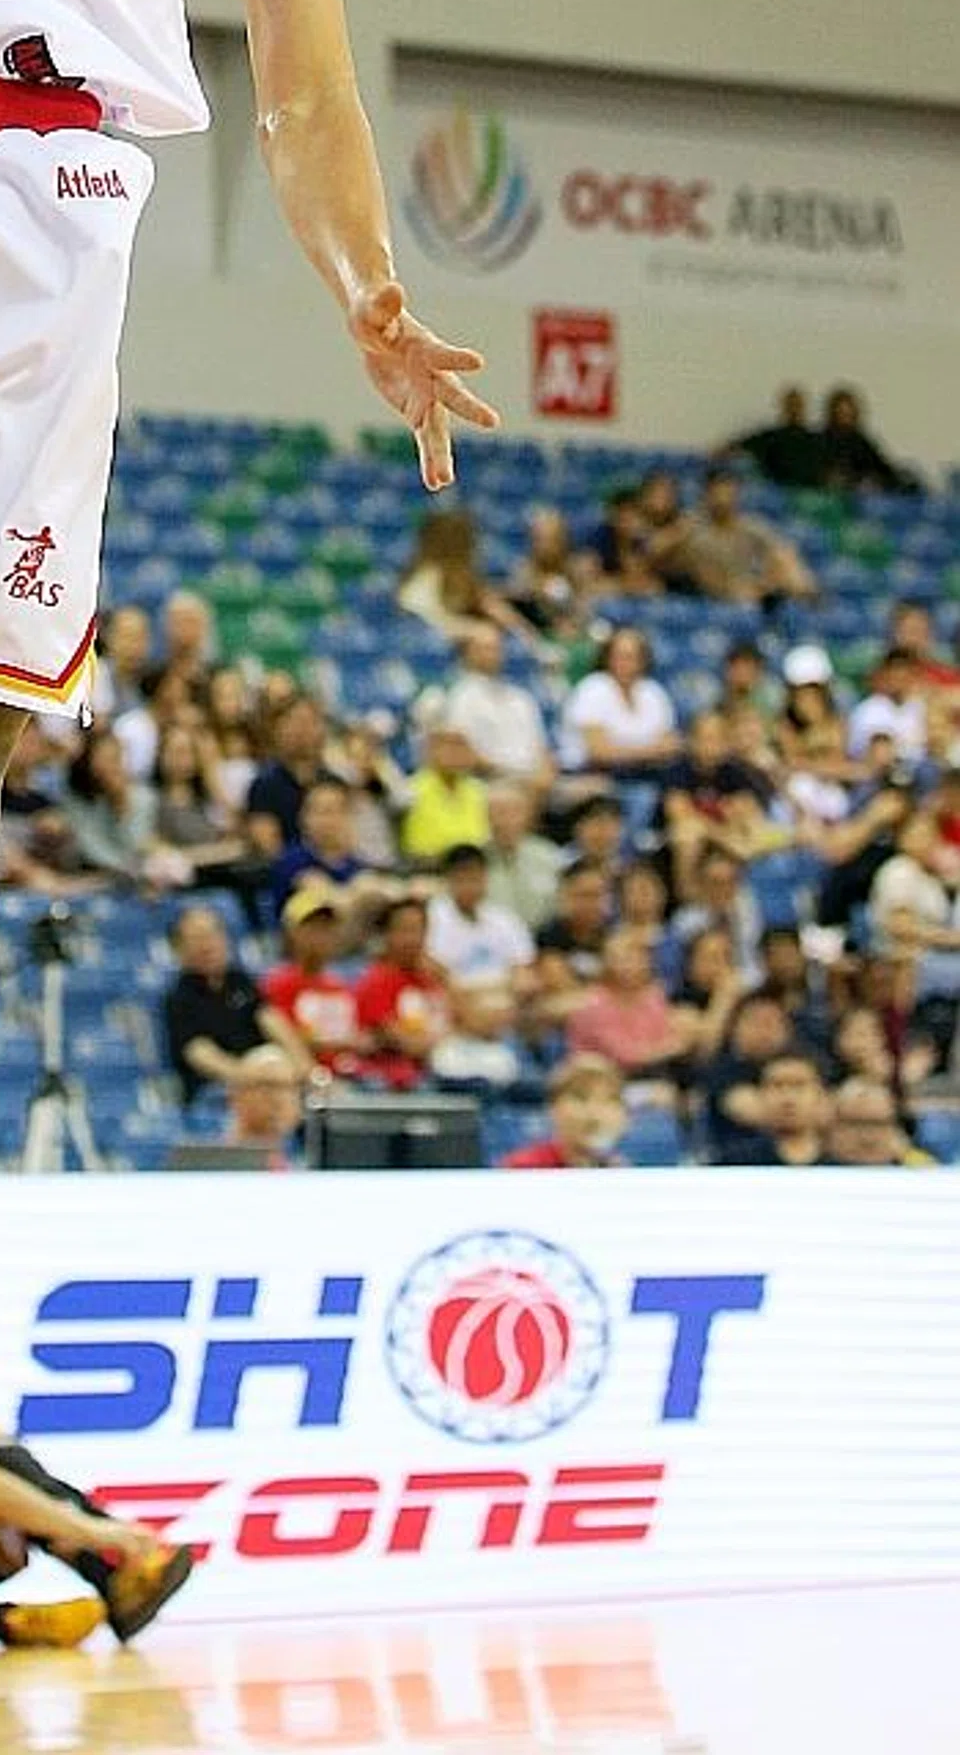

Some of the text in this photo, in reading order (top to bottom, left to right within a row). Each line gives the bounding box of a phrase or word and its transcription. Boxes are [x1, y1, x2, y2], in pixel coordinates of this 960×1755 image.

[561, 169, 904, 255] OCBC ARENA
[537, 340, 613, 414] A7
[8, 575, 64, 607] BAS
